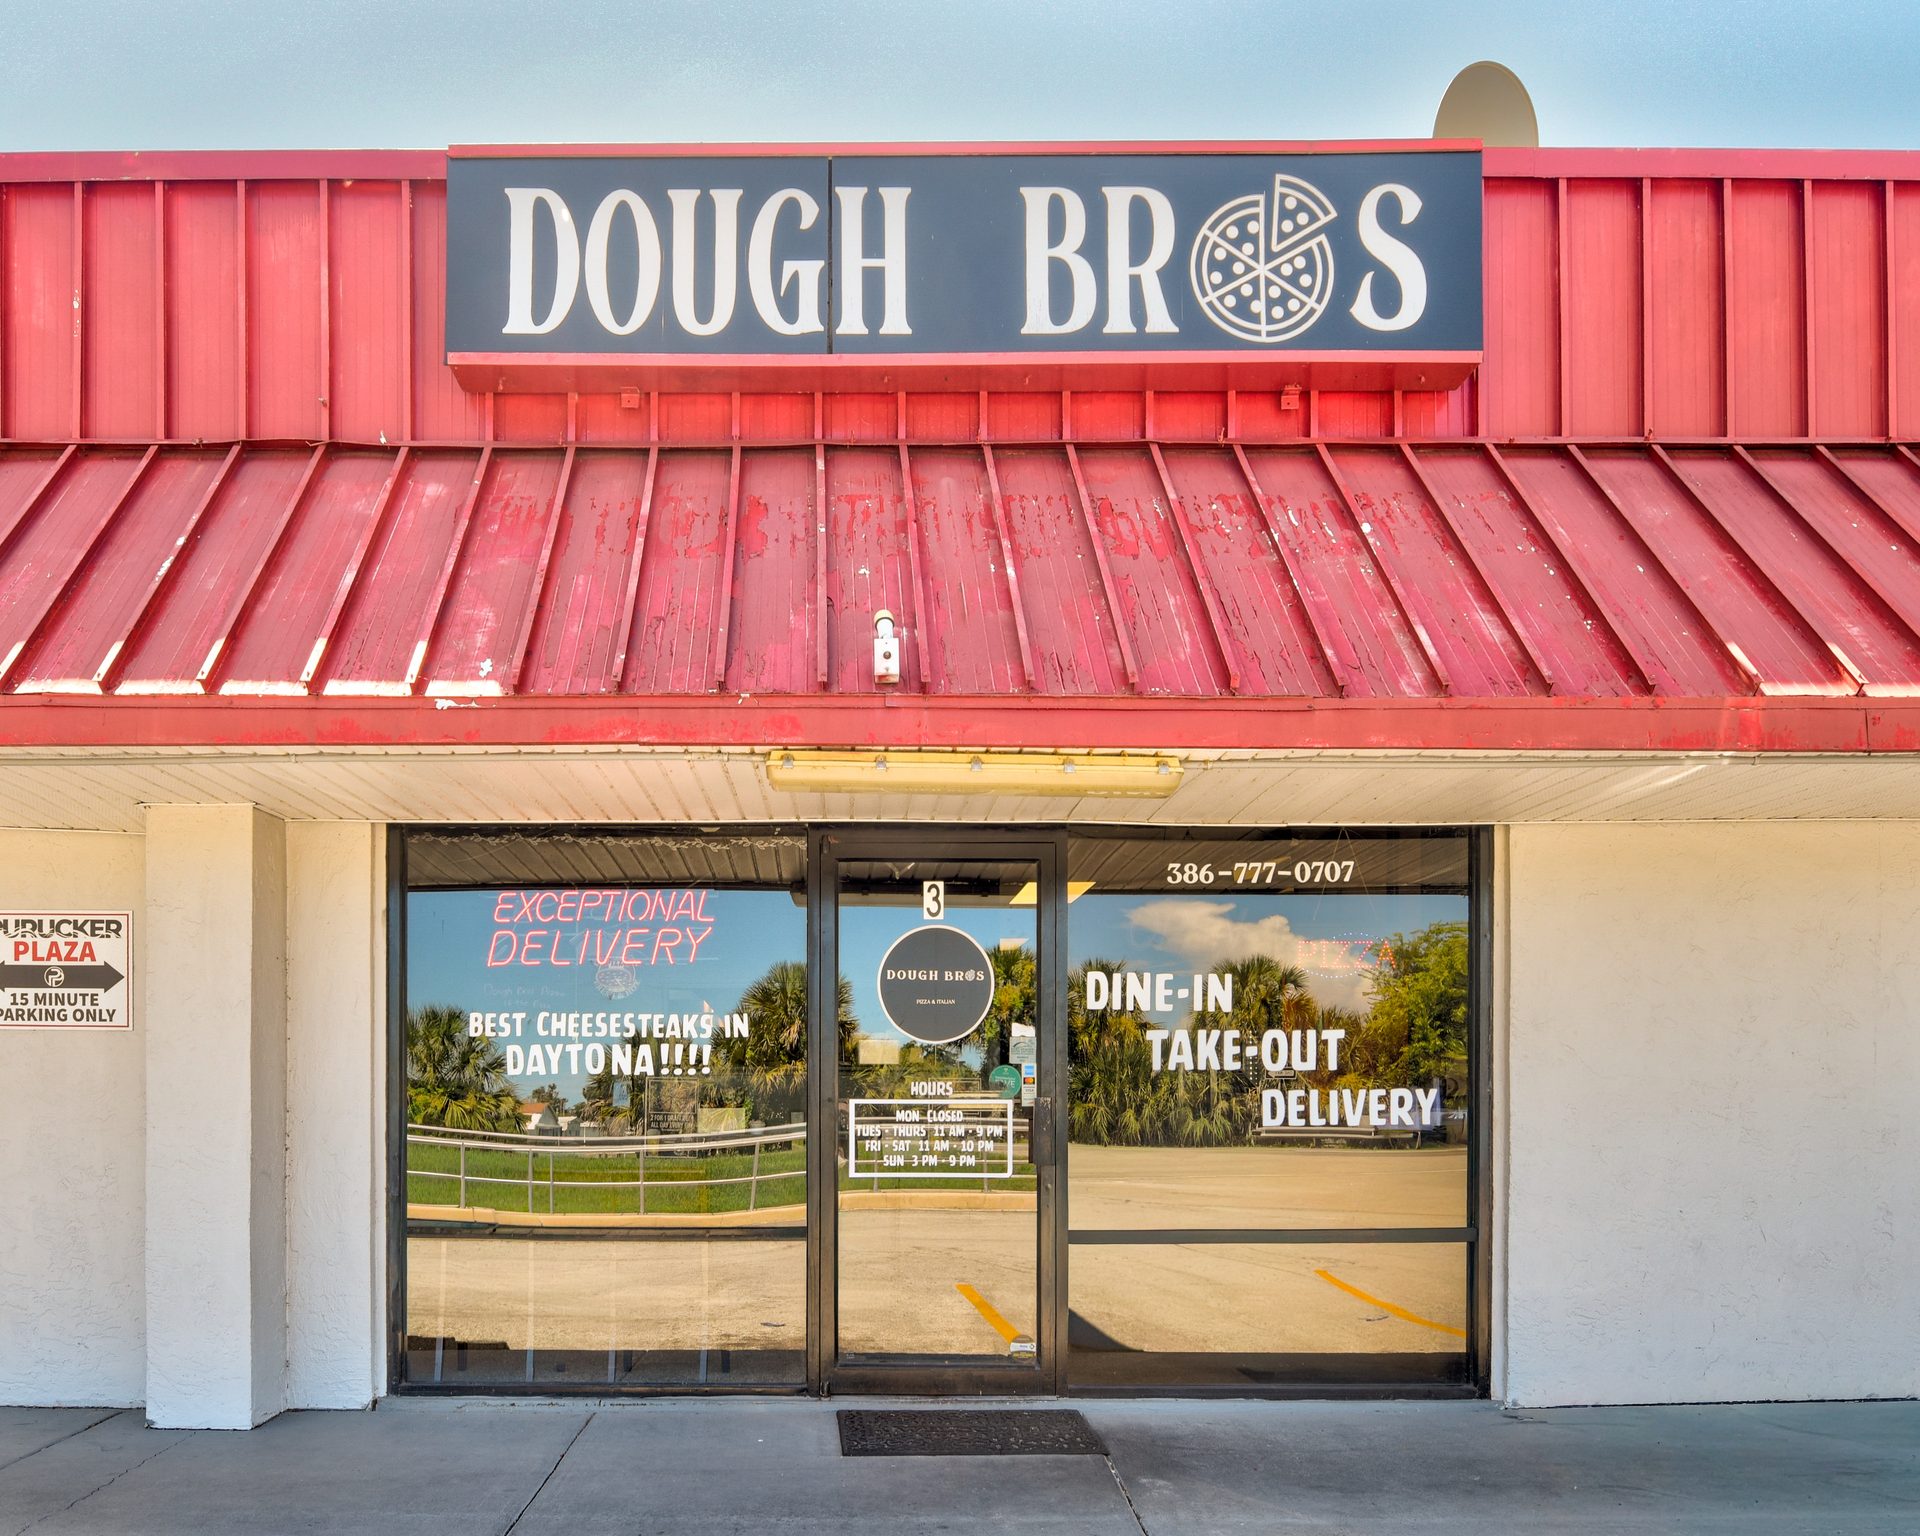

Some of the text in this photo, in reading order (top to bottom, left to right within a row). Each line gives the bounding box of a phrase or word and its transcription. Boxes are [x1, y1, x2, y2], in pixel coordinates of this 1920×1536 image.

[502, 186, 914, 336] DOUGH
[1166, 860, 1355, 885] 386-777-0707
[493, 888, 715, 923] EXCEPTIONAL
[926, 883, 941, 917] 3
[0, 919, 122, 938] URUCKER
[14, 941, 97, 962] PLAZA
[487, 926, 713, 967] DELIVERY
[1297, 939, 1396, 970] PIZZA
[886, 969, 939, 981] DOUGH
[10, 992, 100, 1007] 15 MINUTE
[1086, 970, 1233, 1013] DINE-IN
[72, 1008, 117, 1023] ONLY
[468, 1010, 749, 1040] BEST CHEESESTEAKS IN
[506, 1042, 712, 1077] DAYTONA!!!!
[1145, 1028, 1346, 1072] TAKE-OUT
[910, 1081, 954, 1097] HOURS
[895, 1109, 964, 1123] MON CLOSED
[1261, 1087, 1438, 1127] DELIVERY
[856, 1124, 881, 1137] TUES
[892, 1124, 927, 1137] THURS
[933, 1124, 945, 1137] 11
[949, 1124, 965, 1137] AM
[976, 1124, 983, 1137] 9
[987, 1124, 1003, 1137] PM
[865, 1139, 881, 1152] FRI
[892, 1139, 911, 1152] SAT
[918, 1139, 930, 1152] 11
[933, 1139, 950, 1152] AM
[961, 1139, 974, 1152] 10
[978, 1139, 994, 1152] PM
[883, 1154, 905, 1167] SUN
[912, 1154, 918, 1167] 3
[922, 1154, 938, 1167] PM
[950, 1154, 956, 1167] 9
[959, 1154, 976, 1167] PM
